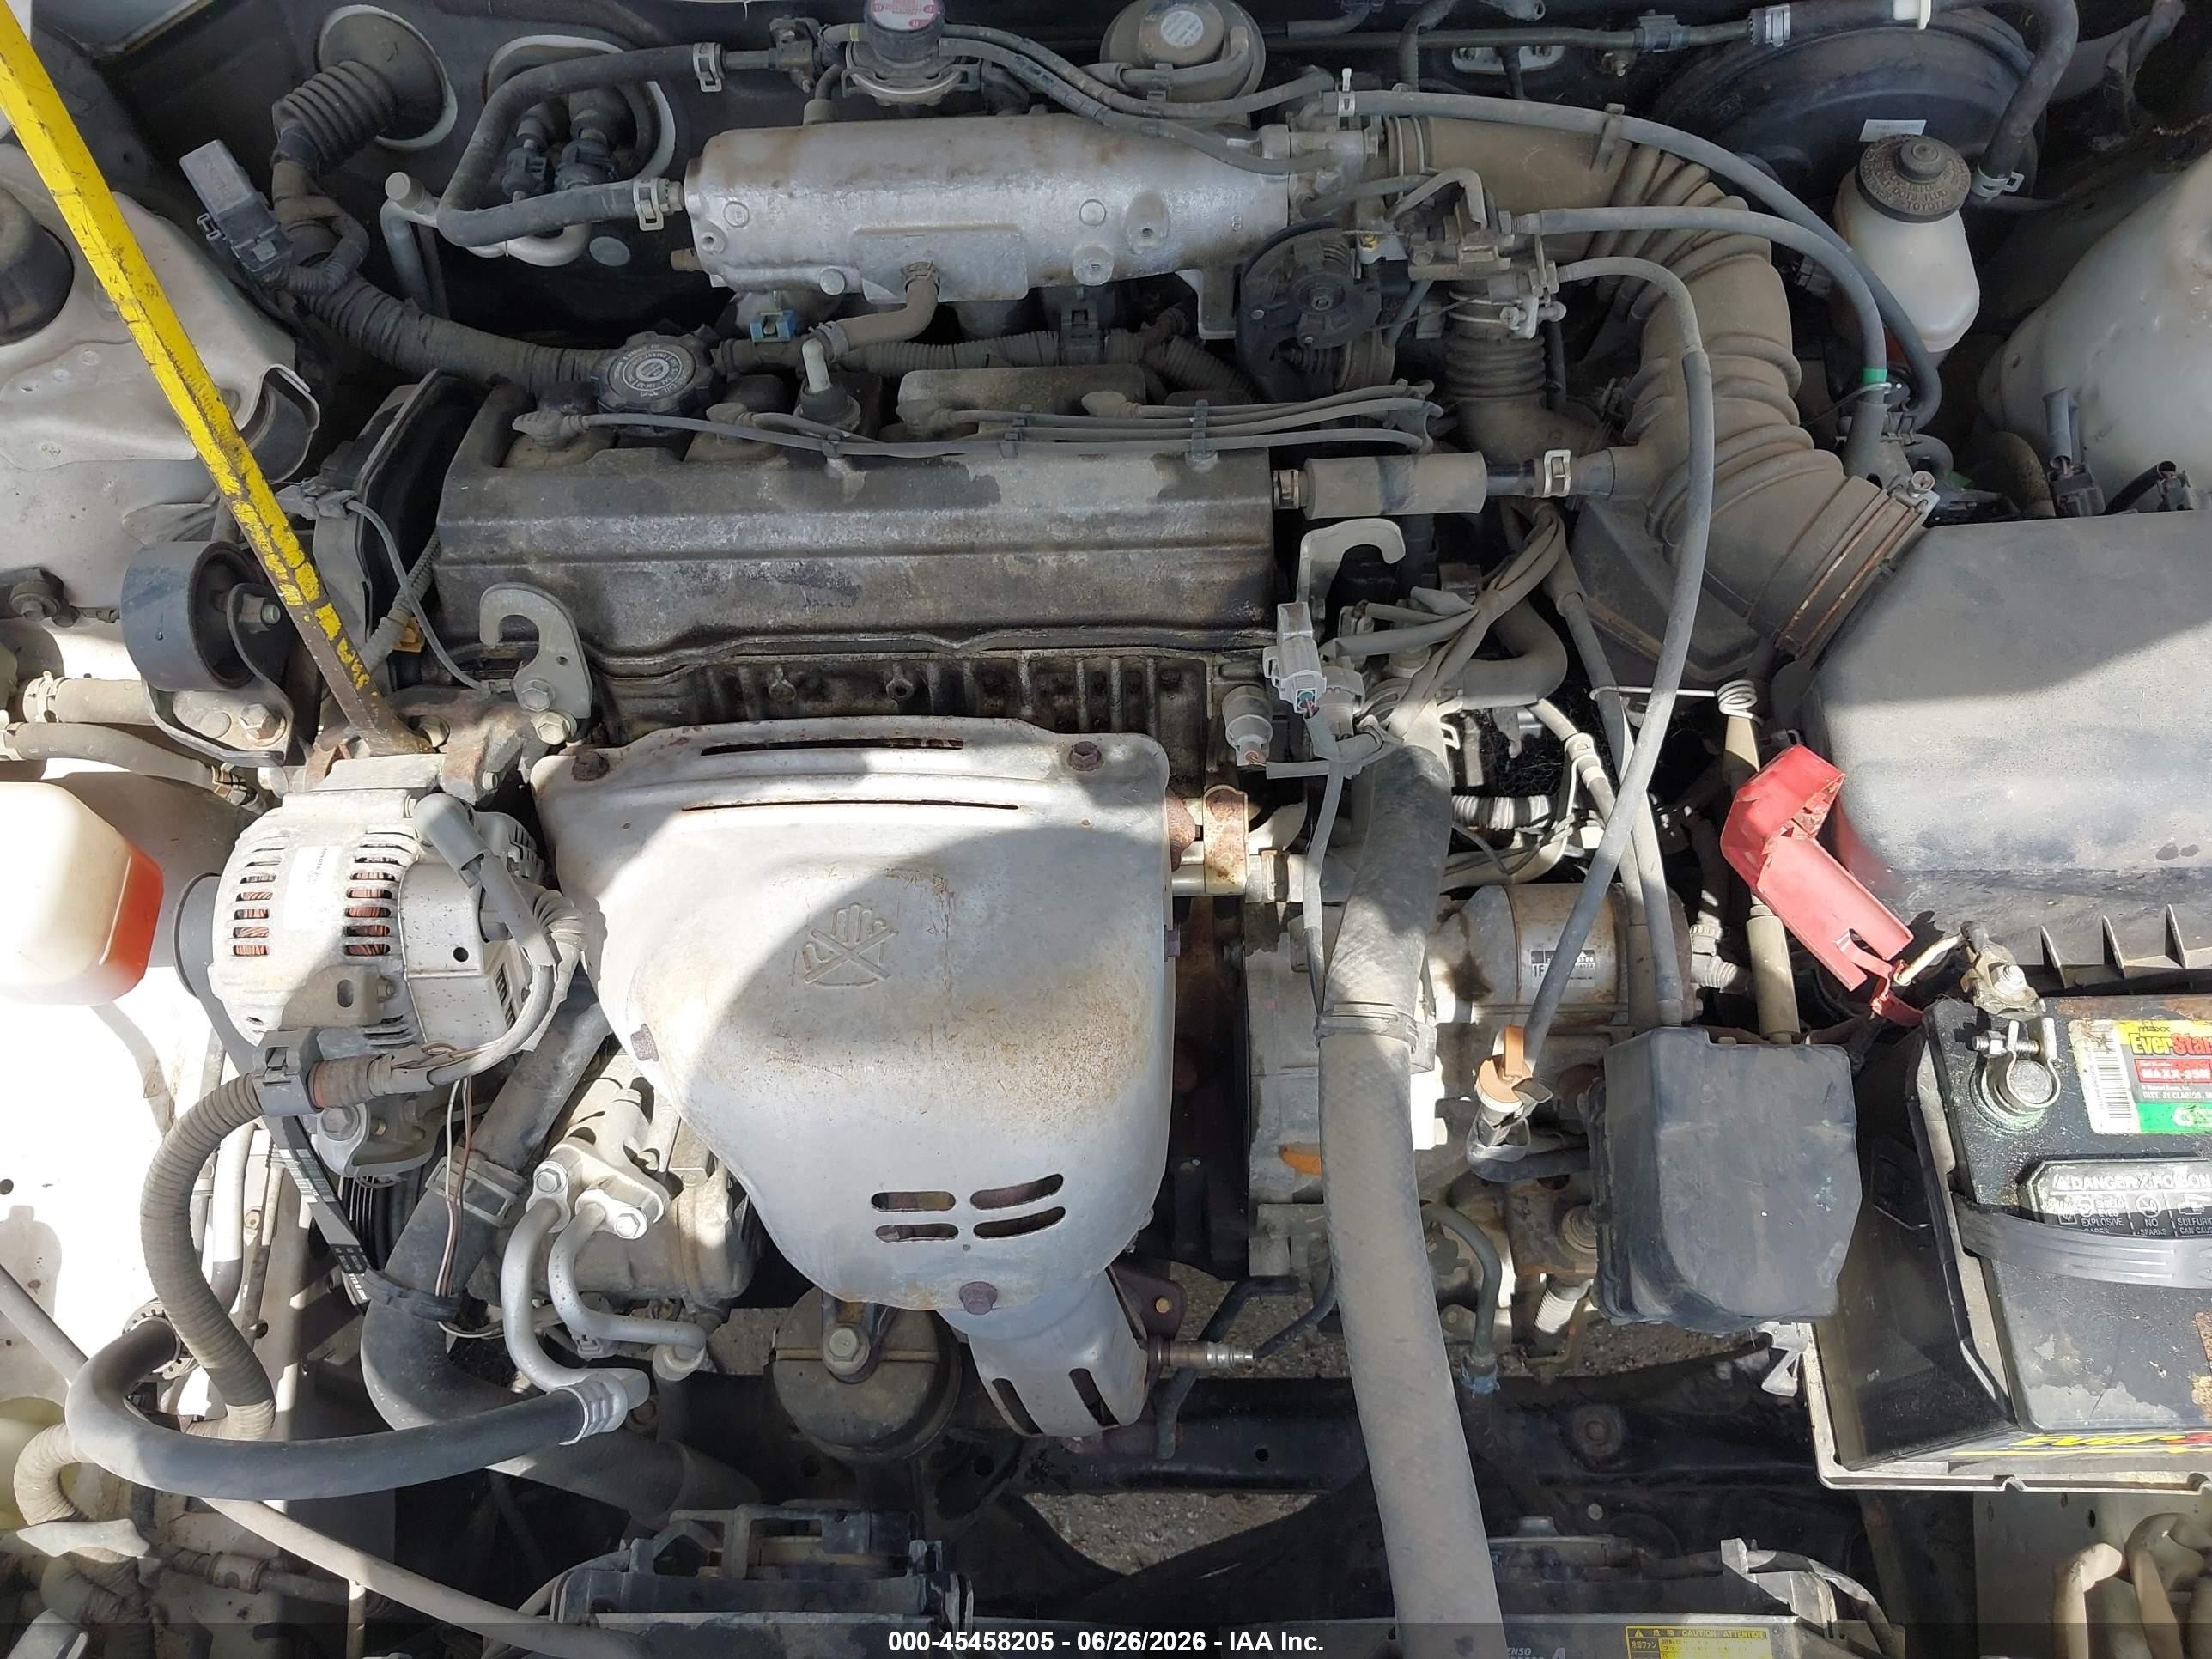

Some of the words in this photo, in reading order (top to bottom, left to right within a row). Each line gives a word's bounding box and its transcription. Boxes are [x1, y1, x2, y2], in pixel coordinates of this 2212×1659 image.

[2081, 1218, 2124, 1227] EXPLOSIVE
[2144, 1218, 2159, 1227] NO
[1723, 1630, 1764, 1638] ATTENTION
[1506, 1647, 1532, 1656] ENSO
